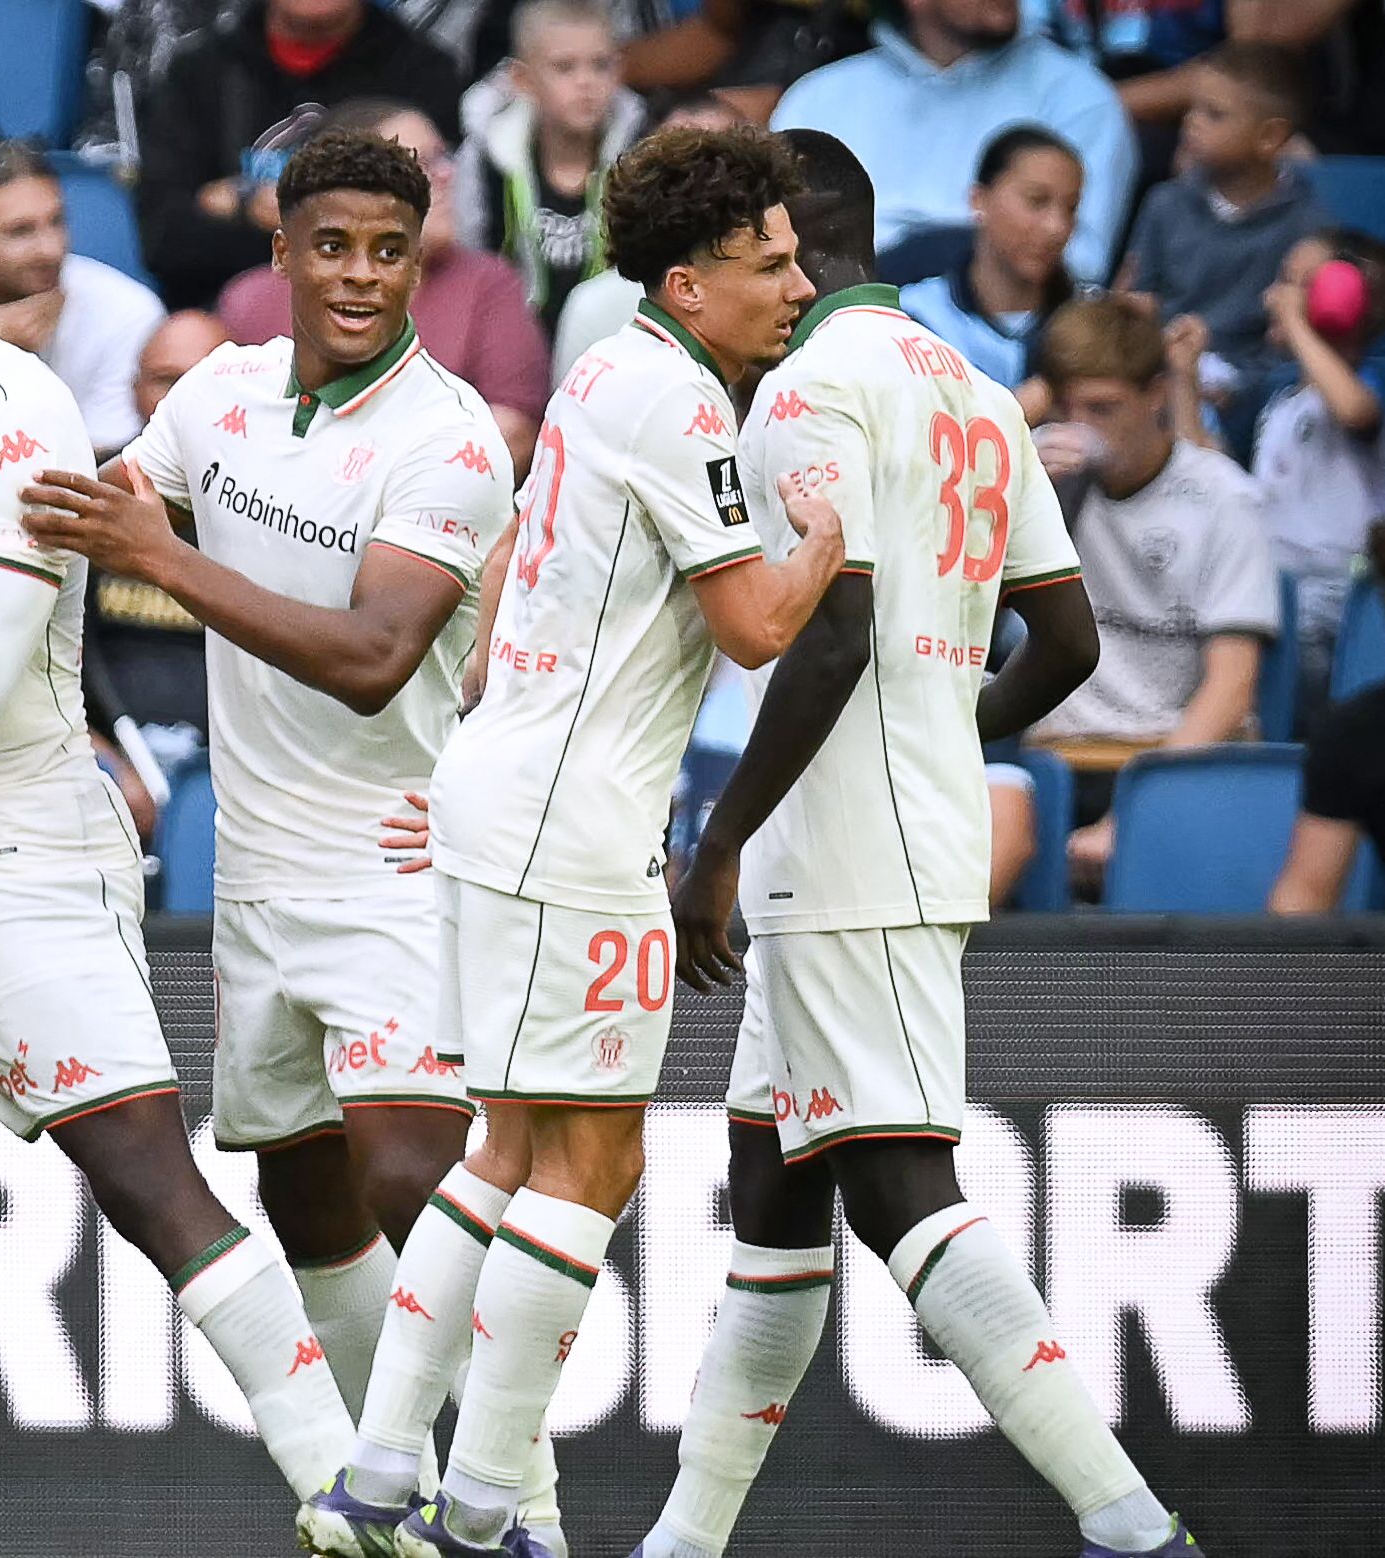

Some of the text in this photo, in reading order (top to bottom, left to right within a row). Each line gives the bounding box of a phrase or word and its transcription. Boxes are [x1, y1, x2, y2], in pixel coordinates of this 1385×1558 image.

[218, 476, 358, 554] Robinhood
[929, 411, 1010, 582] 33
[584, 929, 670, 1012] 20
